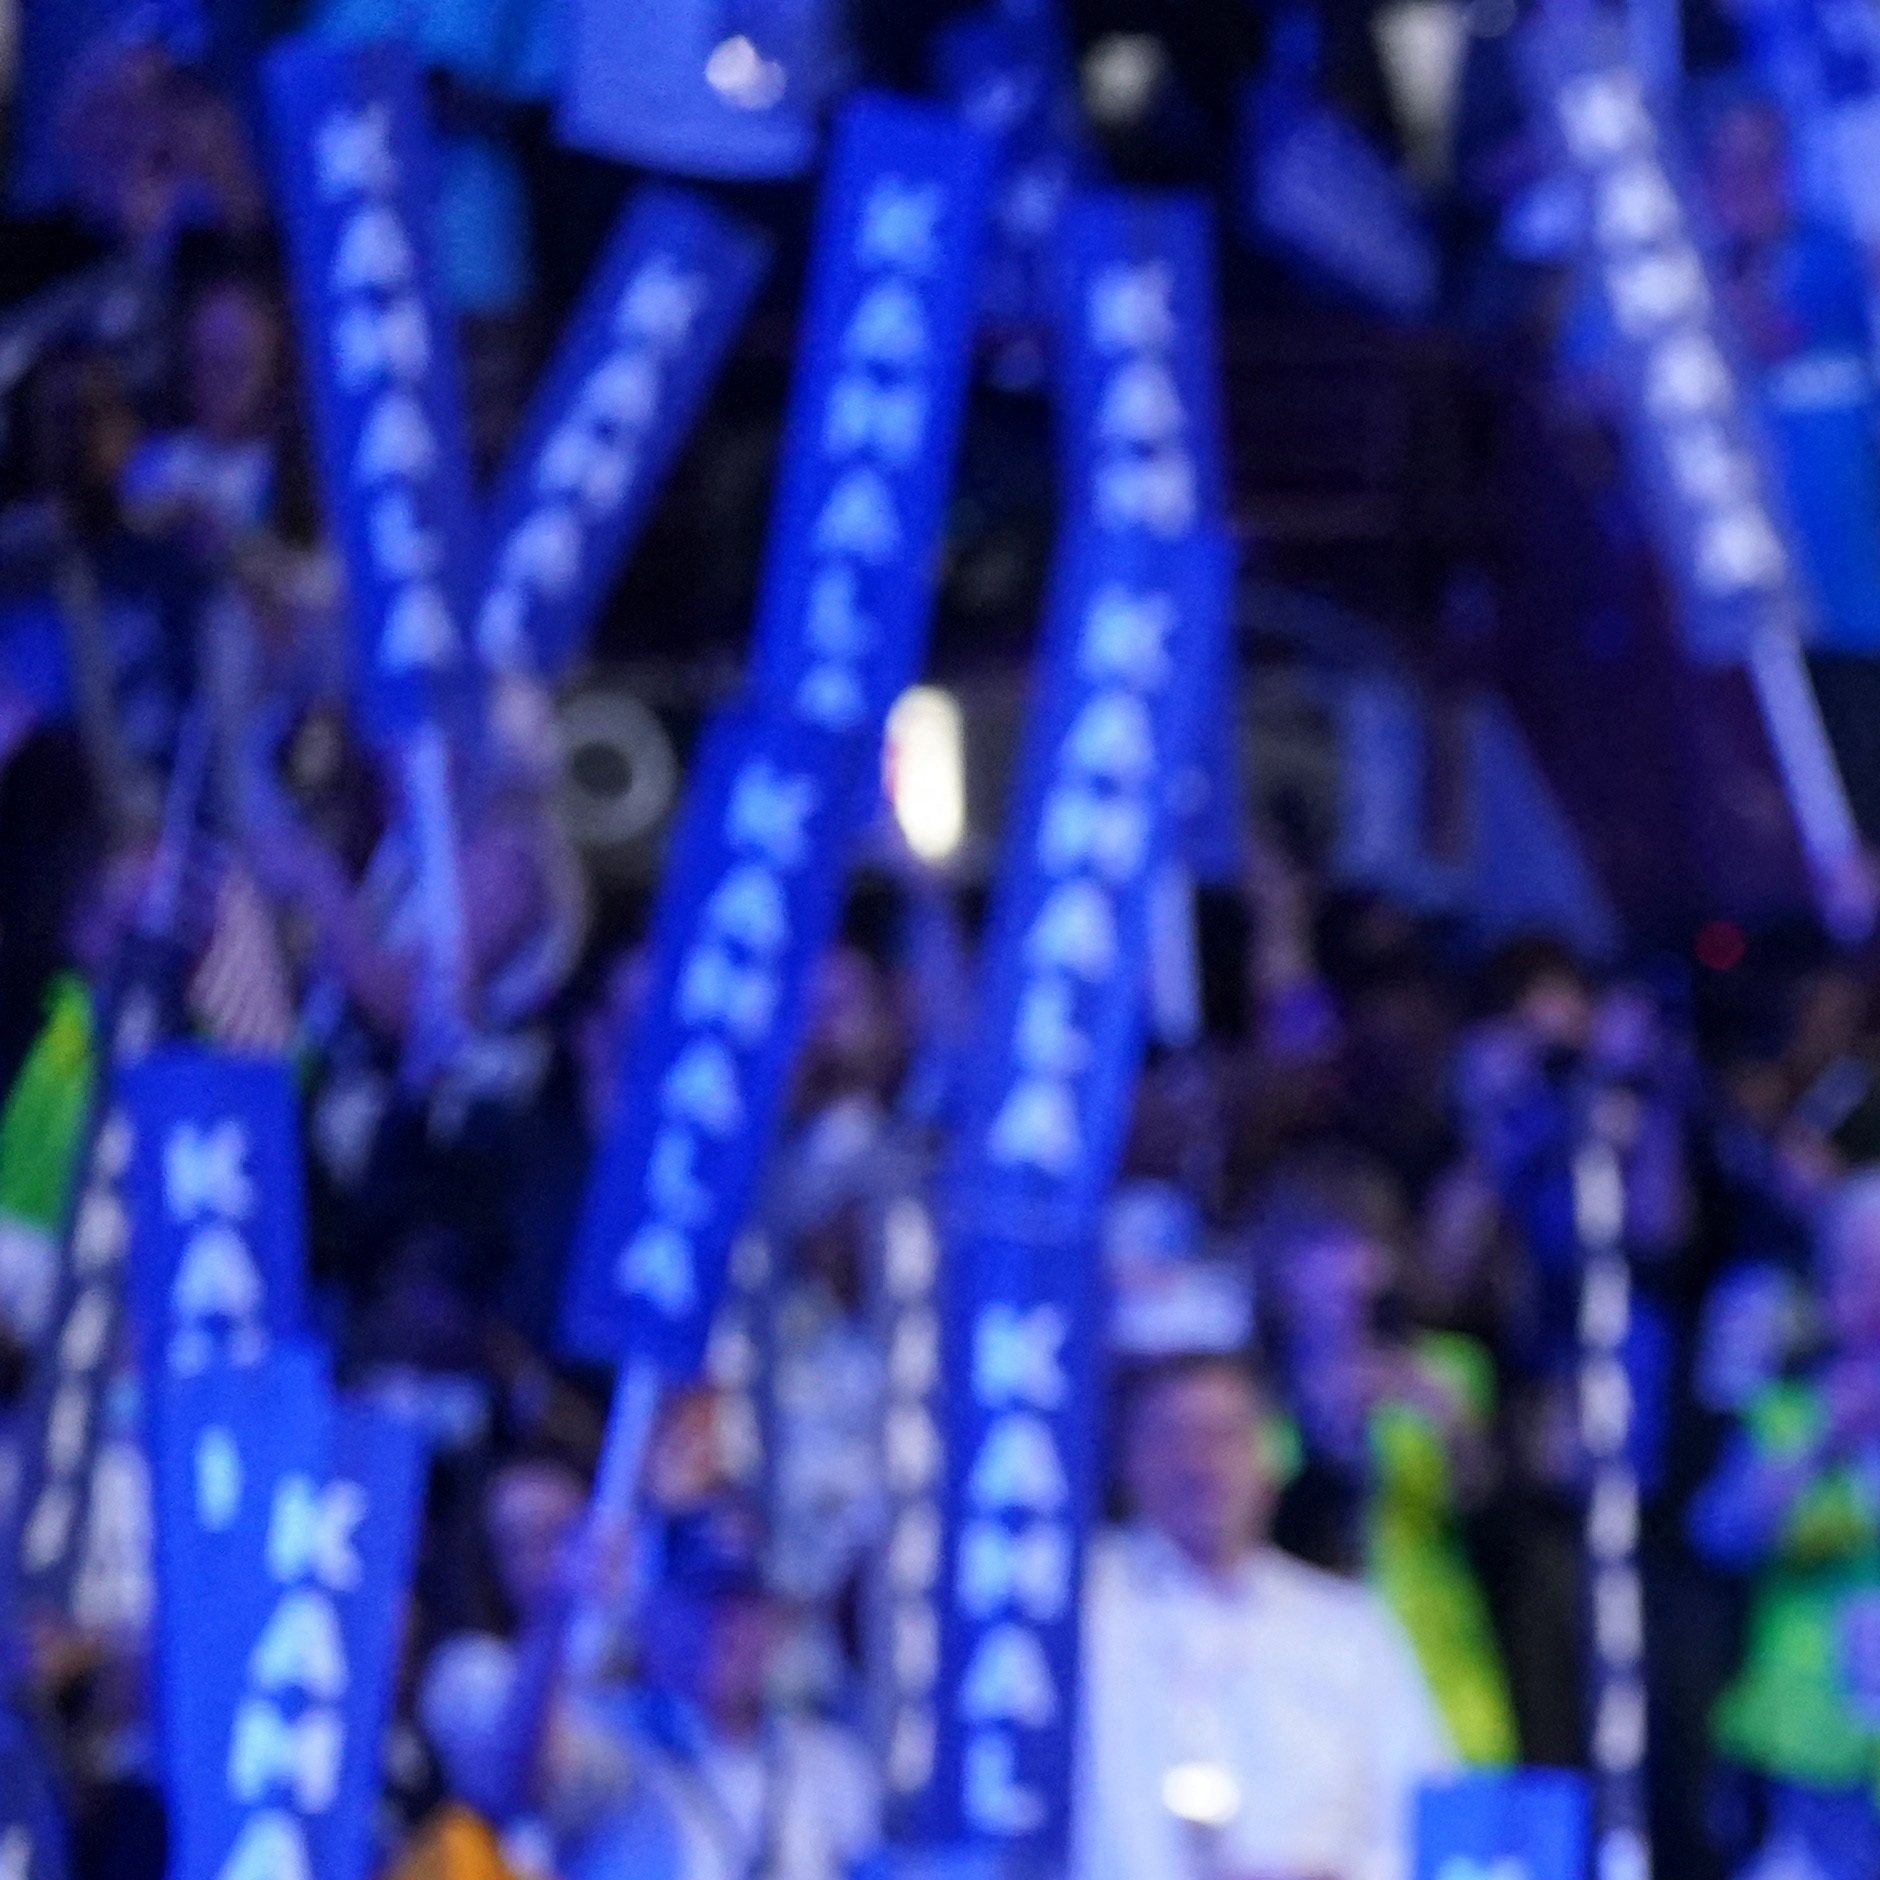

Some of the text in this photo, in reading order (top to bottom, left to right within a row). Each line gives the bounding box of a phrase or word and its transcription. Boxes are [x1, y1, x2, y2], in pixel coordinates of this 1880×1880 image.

[620, 760, 815, 1320] KAMALA
[988, 598, 1172, 1175] KAMALA
[960, 1303, 1070, 1832] KAMAL
